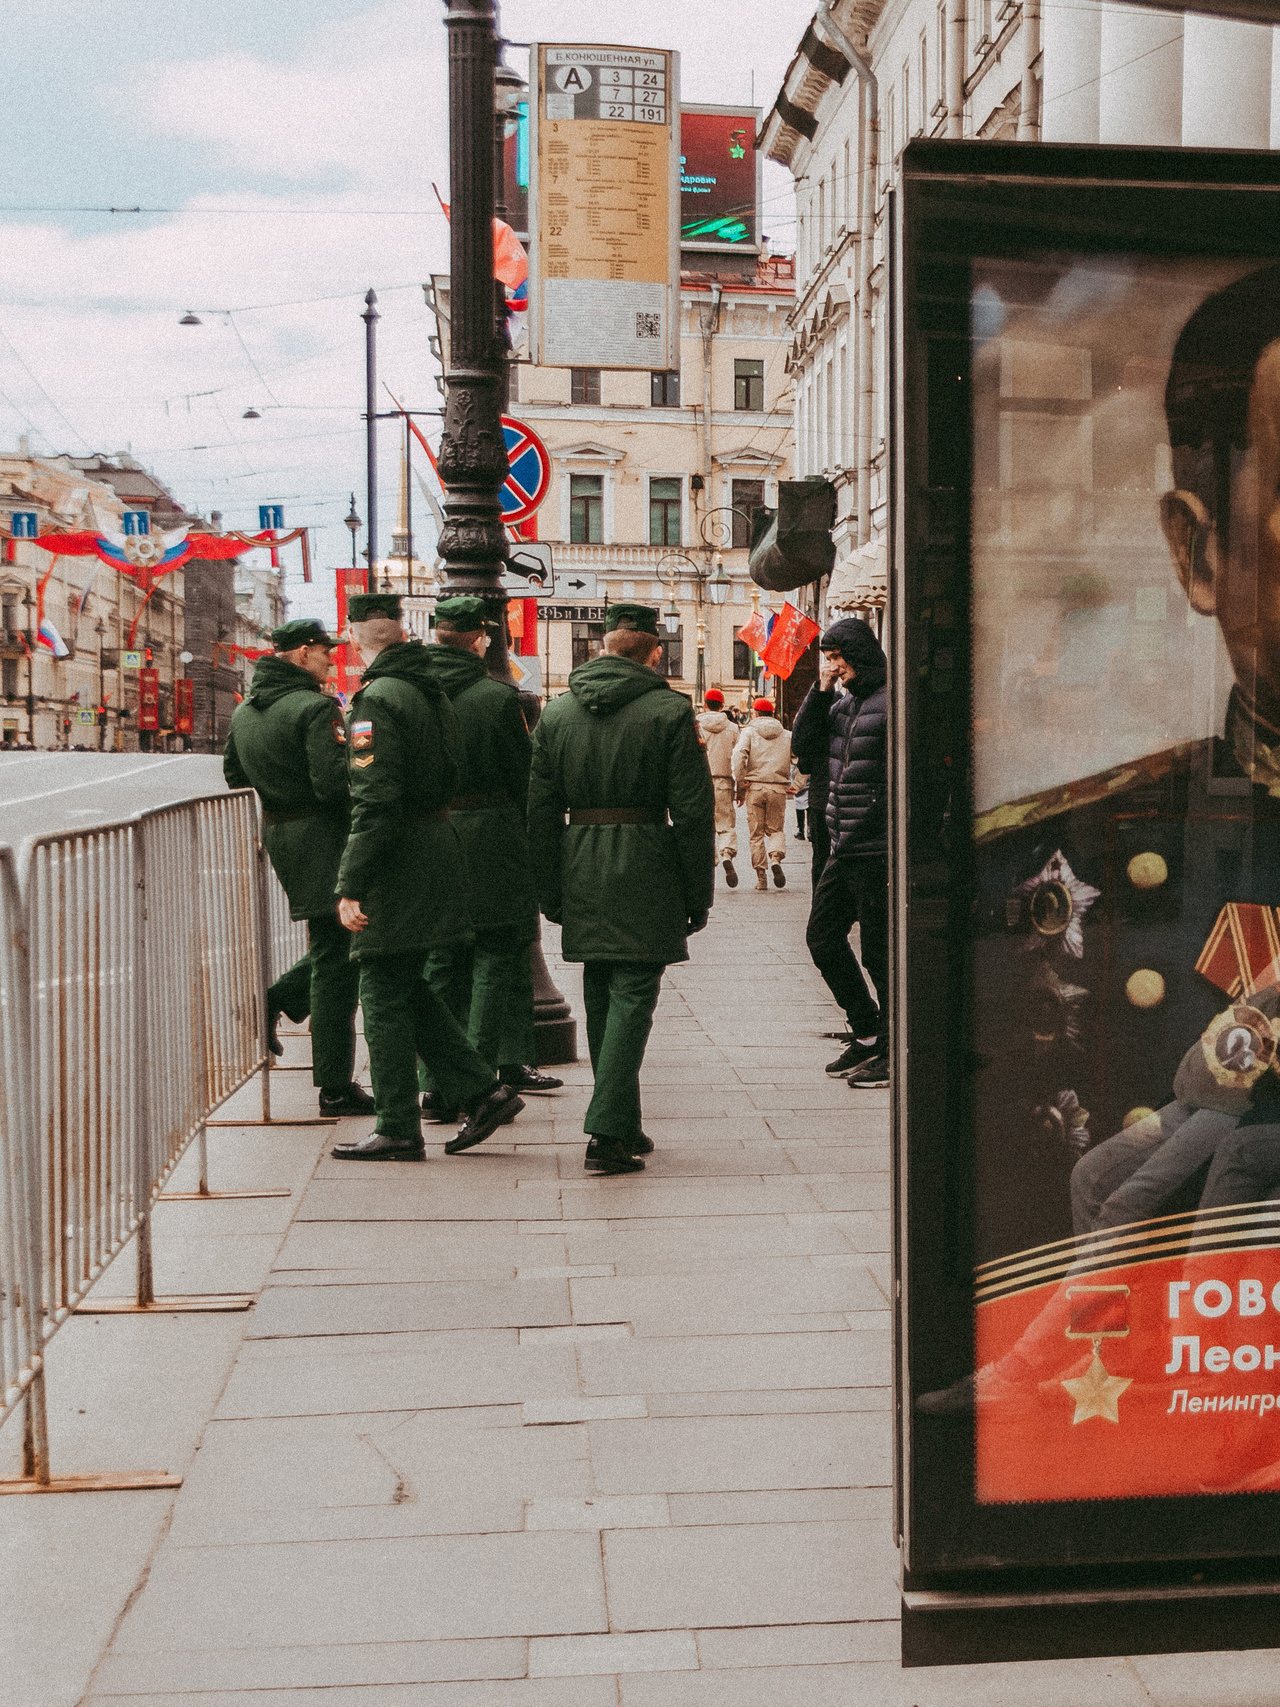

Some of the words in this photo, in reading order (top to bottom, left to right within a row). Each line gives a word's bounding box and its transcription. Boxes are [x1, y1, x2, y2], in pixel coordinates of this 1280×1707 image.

[613, 71, 621, 83] 3
[643, 73, 658, 86] 24
[612, 89, 620, 100] 7
[643, 91, 658, 103] 27
[608, 106, 625, 118] 22
[640, 108, 661, 121] 191
[552, 123, 559, 133] 3
[552, 175, 559, 184] 7
[549, 227, 563, 236] 22
[538, 606, 563, 619] ФЪ
[588, 607, 606, 620] БЕ
